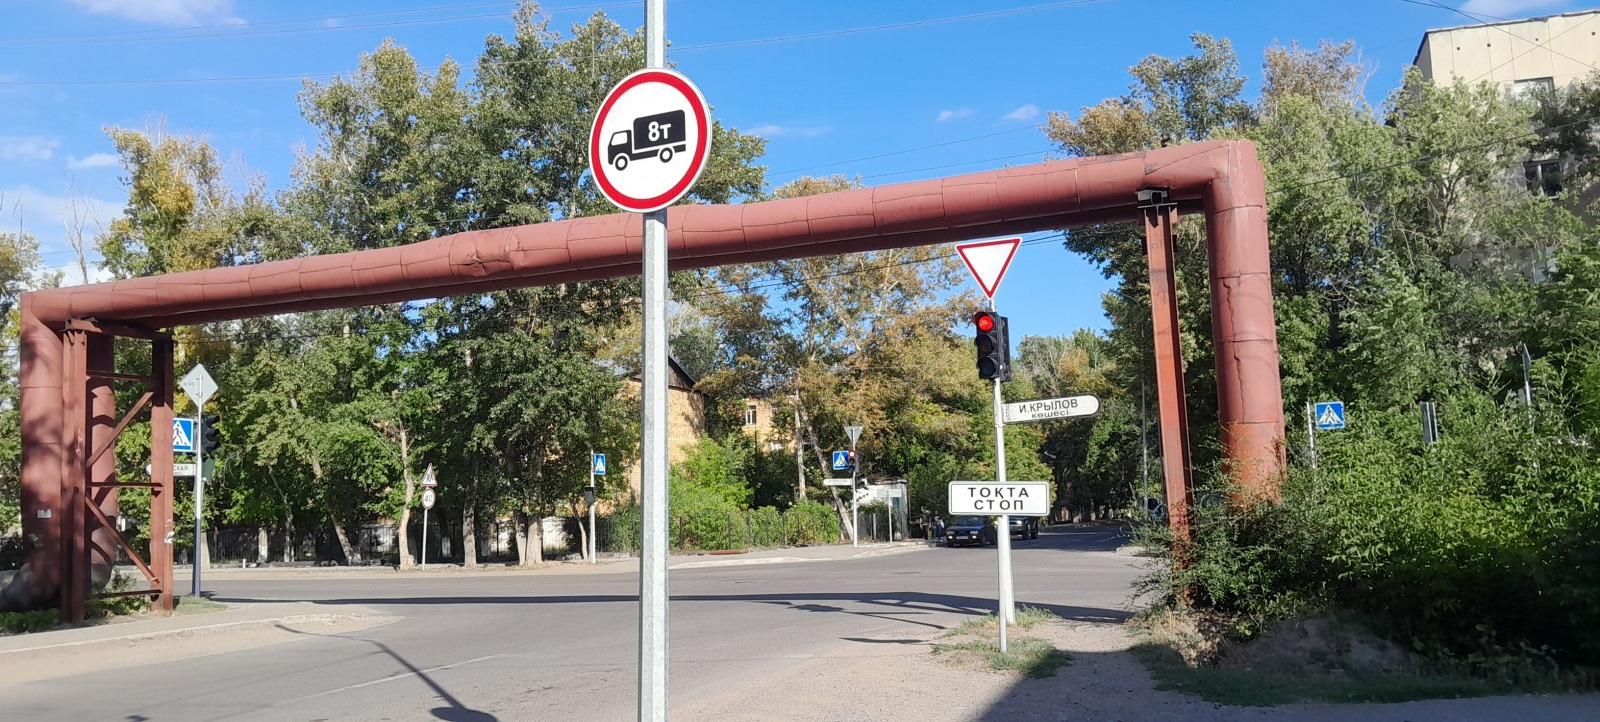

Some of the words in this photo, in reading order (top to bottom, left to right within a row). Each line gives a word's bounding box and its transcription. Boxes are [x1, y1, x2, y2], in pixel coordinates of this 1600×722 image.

[1019, 398, 1078, 413] И.КРЫЛОВ
[1031, 410, 1069, 419] көшесі
[425, 494, 433, 502] 40
[967, 487, 1029, 499] ТОҚТА
[973, 499, 1024, 510] СТОП
